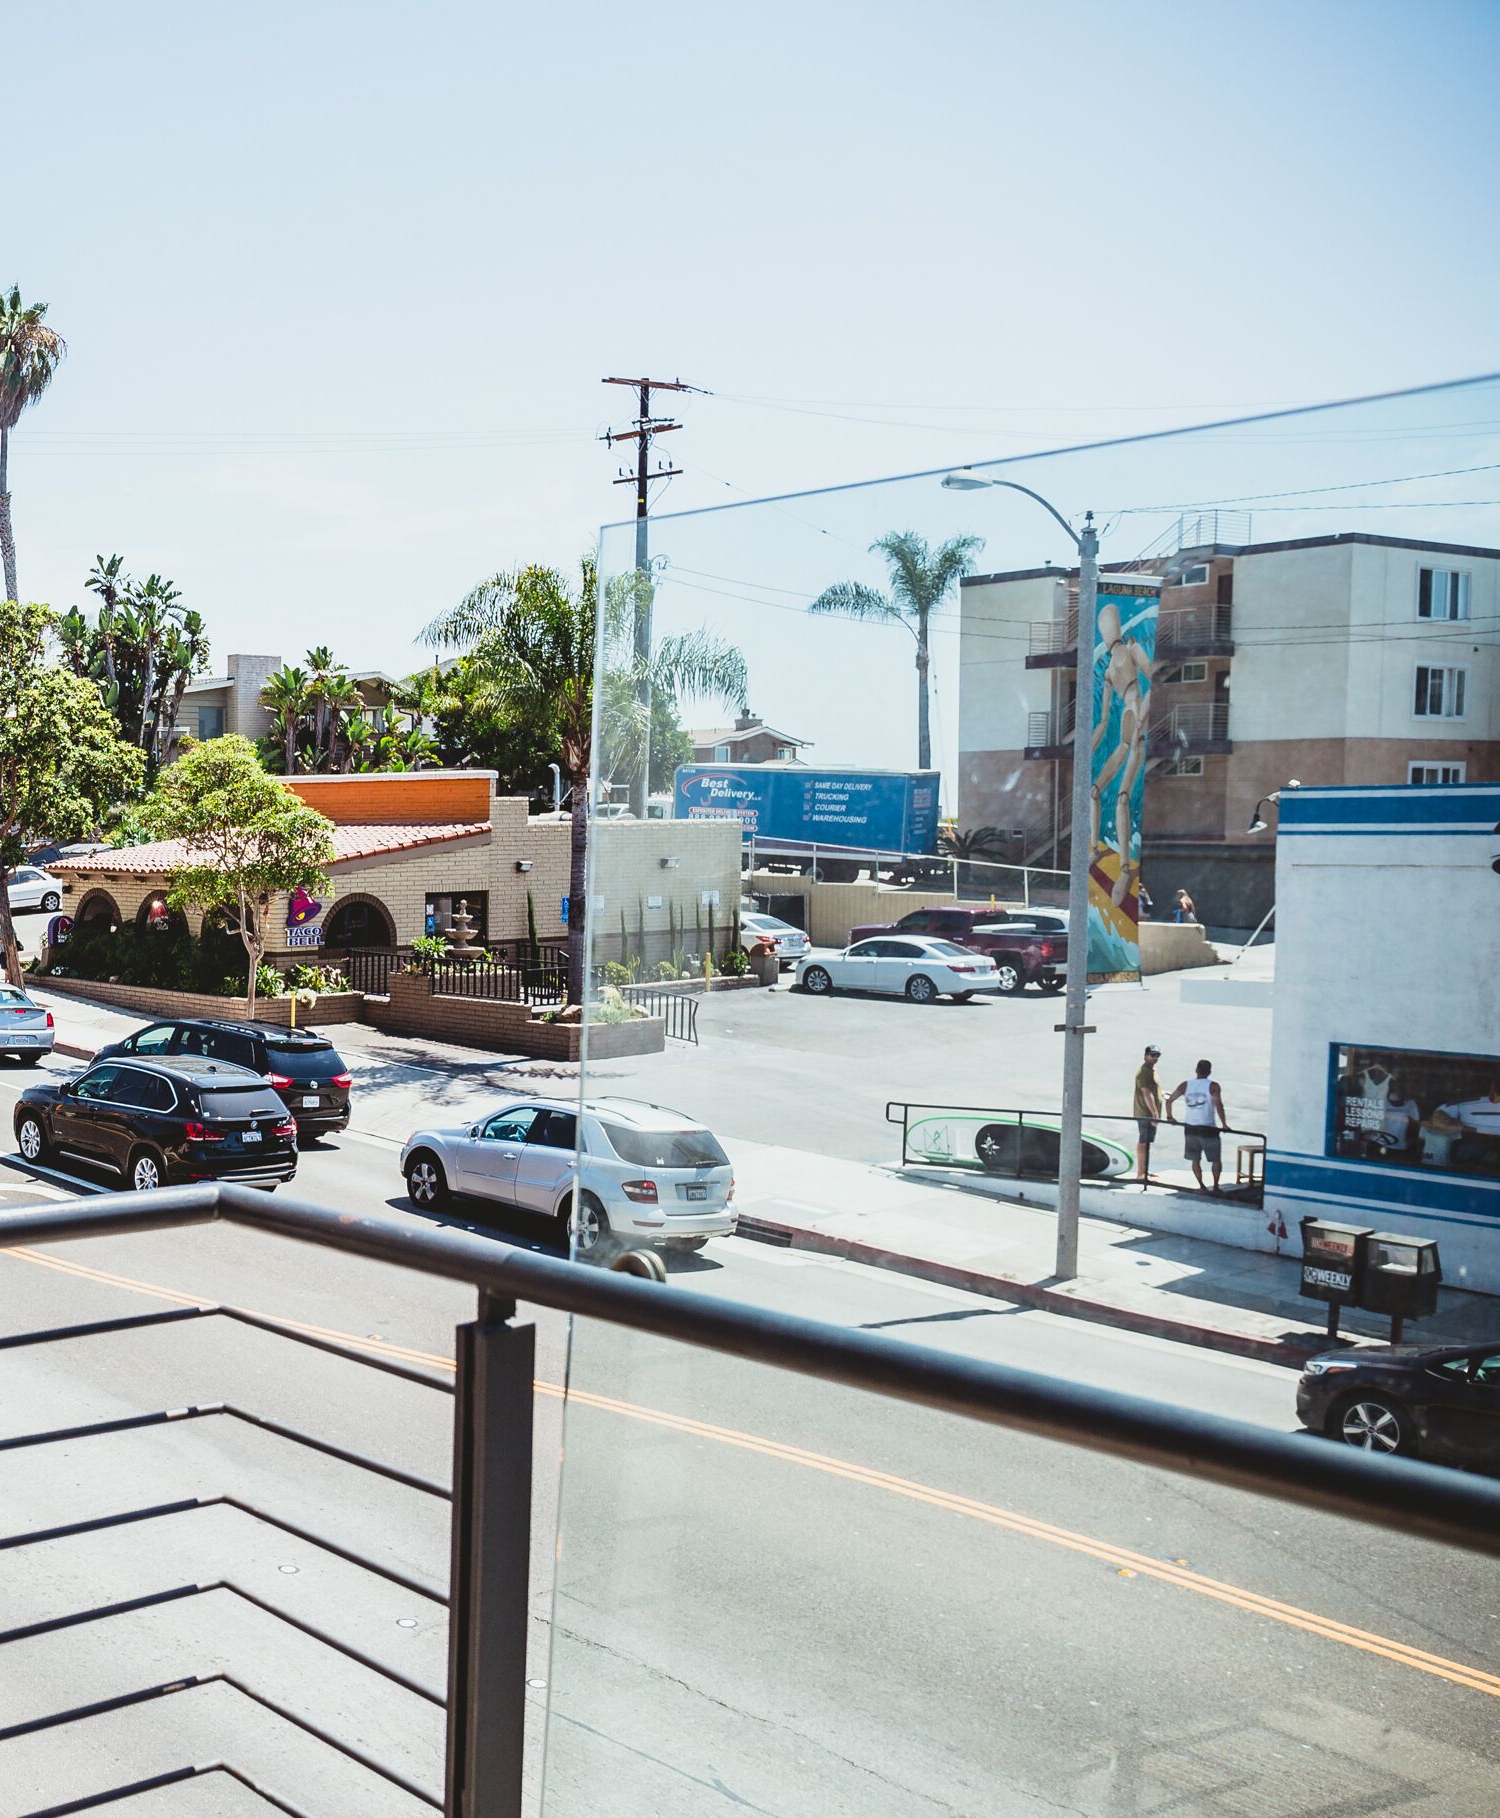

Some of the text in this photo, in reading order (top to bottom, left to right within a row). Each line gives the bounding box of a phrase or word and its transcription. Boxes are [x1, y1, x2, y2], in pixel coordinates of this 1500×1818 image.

[1102, 583, 1157, 598] LAGUNA BEACH
[701, 778, 729, 788] Best
[814, 781, 873, 791] SAME DAY DELIVERY
[710, 788, 755, 801] Delivery
[815, 792, 850, 801] TRUCKING
[814, 803, 847, 812] COURIER
[812, 814, 867, 824] WAREHOUSING
[285, 927, 323, 937] TACO
[286, 936, 325, 947] BELL
[1345, 1096, 1384, 1110] RENTALS
[1344, 1106, 1385, 1120] LESSONS
[1344, 1117, 1381, 1130] REPAIRS
[1317, 1268, 1352, 1288] WEEKLY
